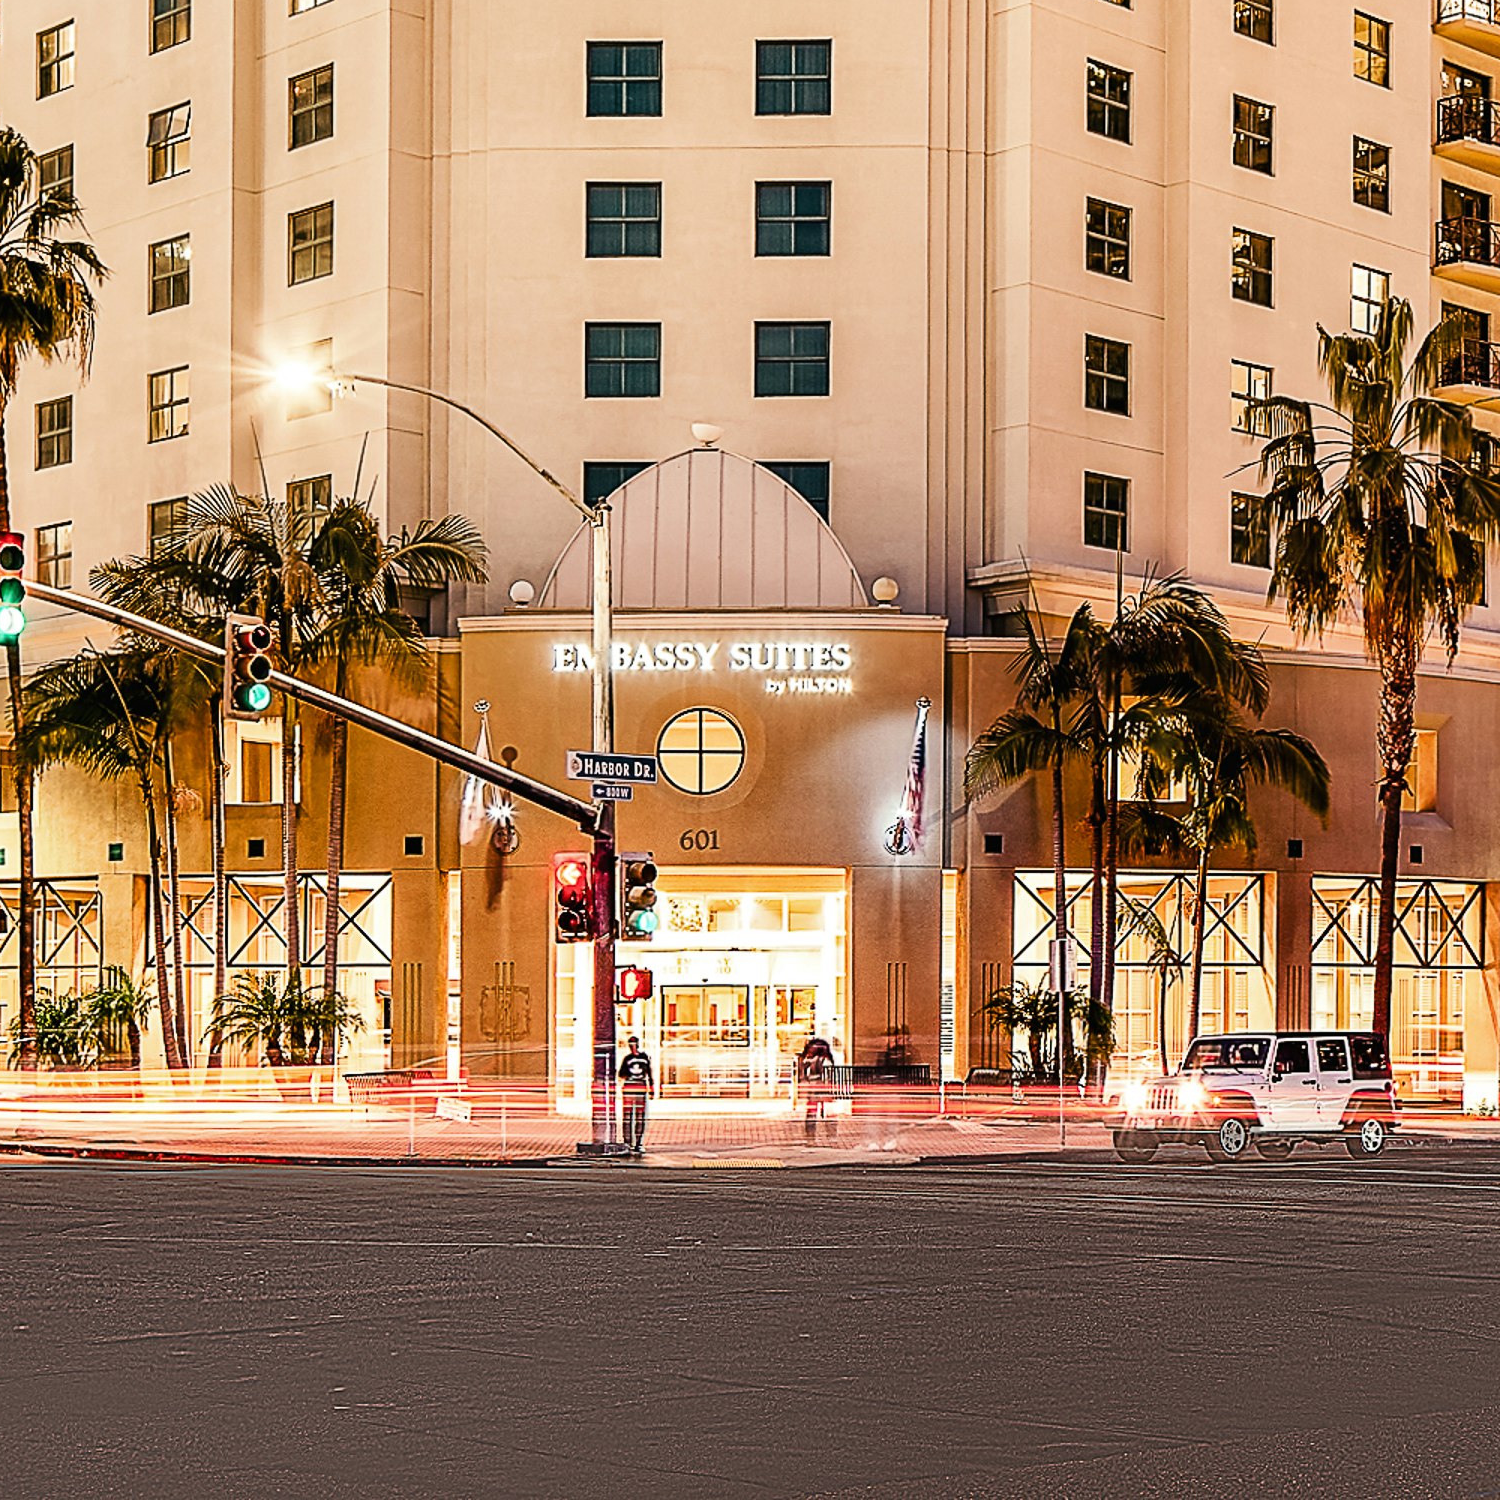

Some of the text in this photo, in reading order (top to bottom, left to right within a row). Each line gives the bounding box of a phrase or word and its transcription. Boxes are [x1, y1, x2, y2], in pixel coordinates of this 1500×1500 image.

[729, 642, 852, 672] SUITES
[765, 678, 853, 695] by HILTON
[584, 757, 654, 779] HARBOR DR.
[679, 828, 721, 851] 601
